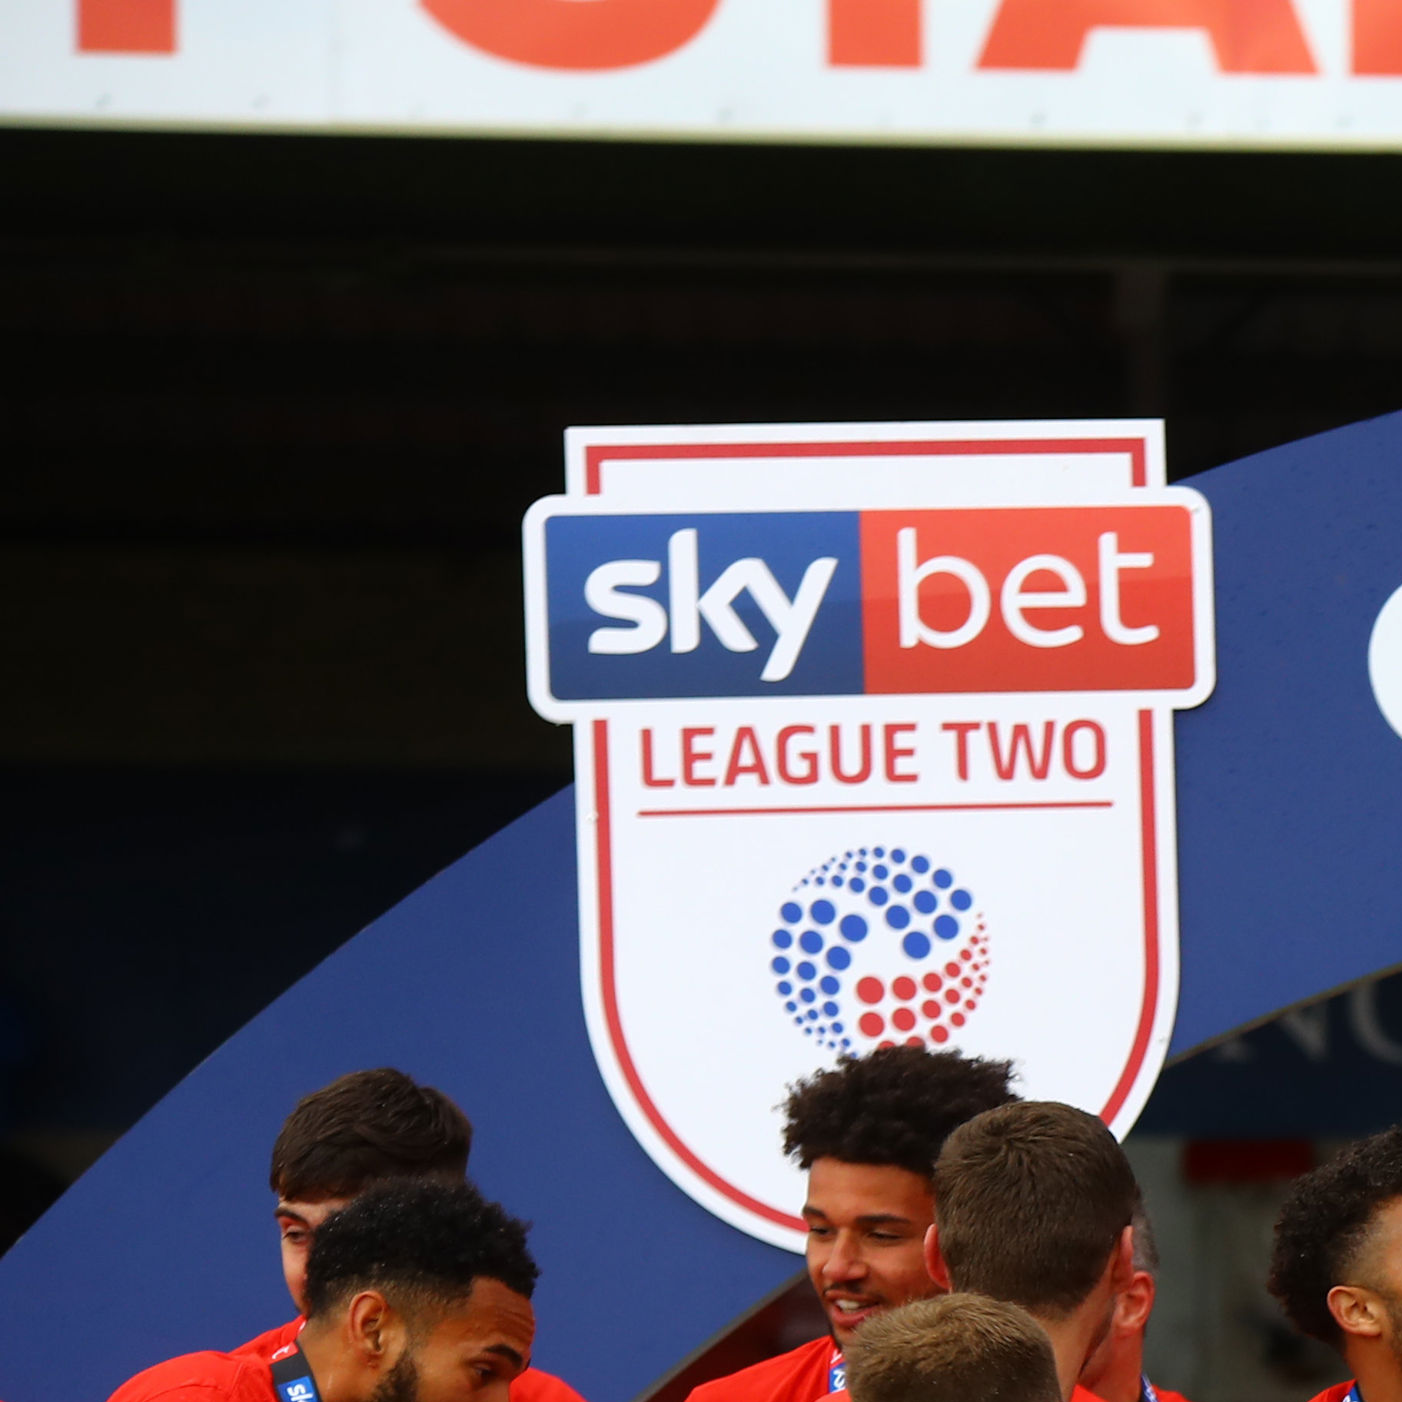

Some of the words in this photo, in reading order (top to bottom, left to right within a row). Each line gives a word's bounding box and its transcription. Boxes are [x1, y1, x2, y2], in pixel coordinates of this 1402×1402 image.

[585, 529, 837, 681] sky
[897, 527, 1159, 648] bet
[641, 722, 919, 788] LEAGUE
[942, 719, 1107, 781] TWO
